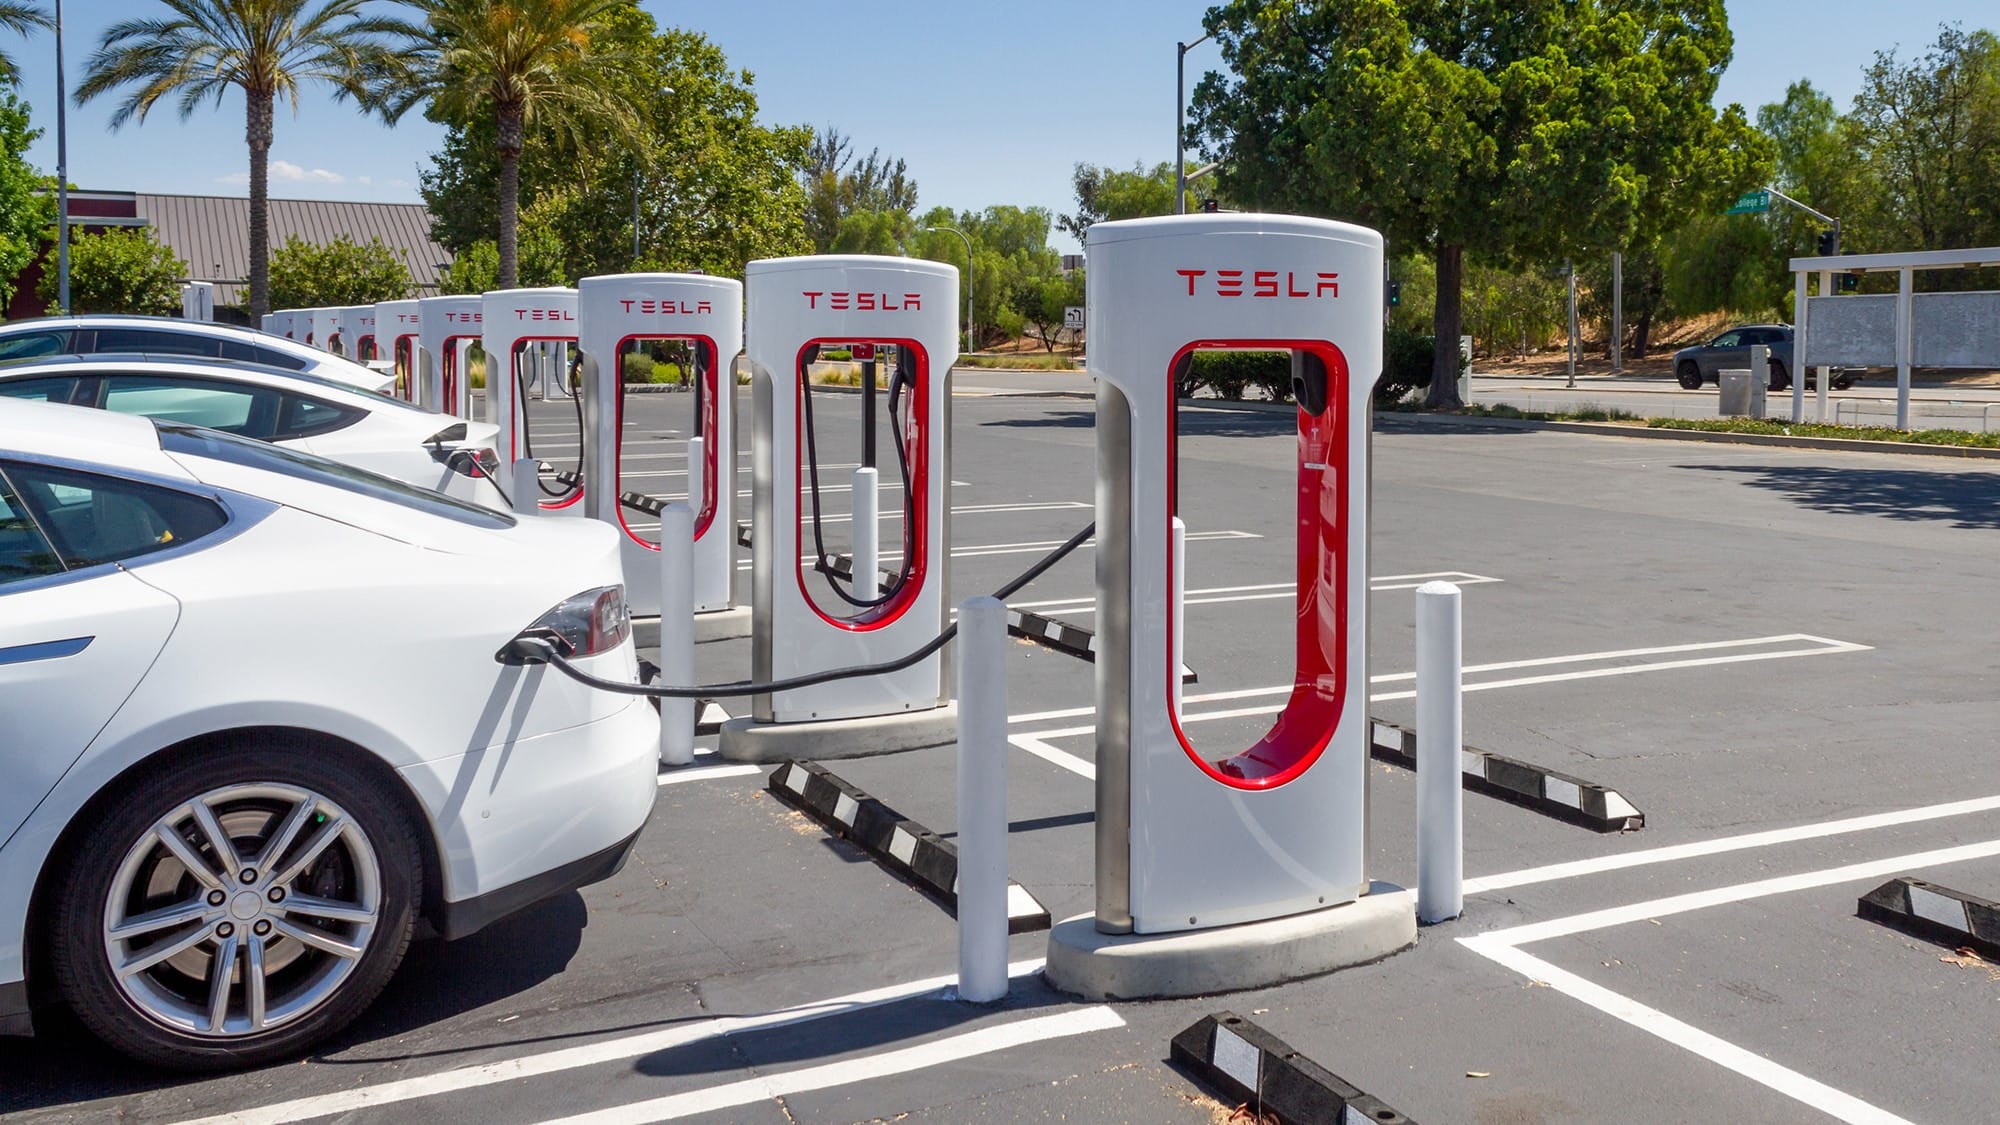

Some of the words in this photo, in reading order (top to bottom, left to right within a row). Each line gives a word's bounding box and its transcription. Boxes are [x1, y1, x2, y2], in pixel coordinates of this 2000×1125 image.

[1176, 269, 1339, 298] TESLA
[621, 301, 711, 315] TESLA
[802, 292, 921, 311] TESLA
[446, 312, 483, 323] TES
[514, 309, 575, 321] TESL
